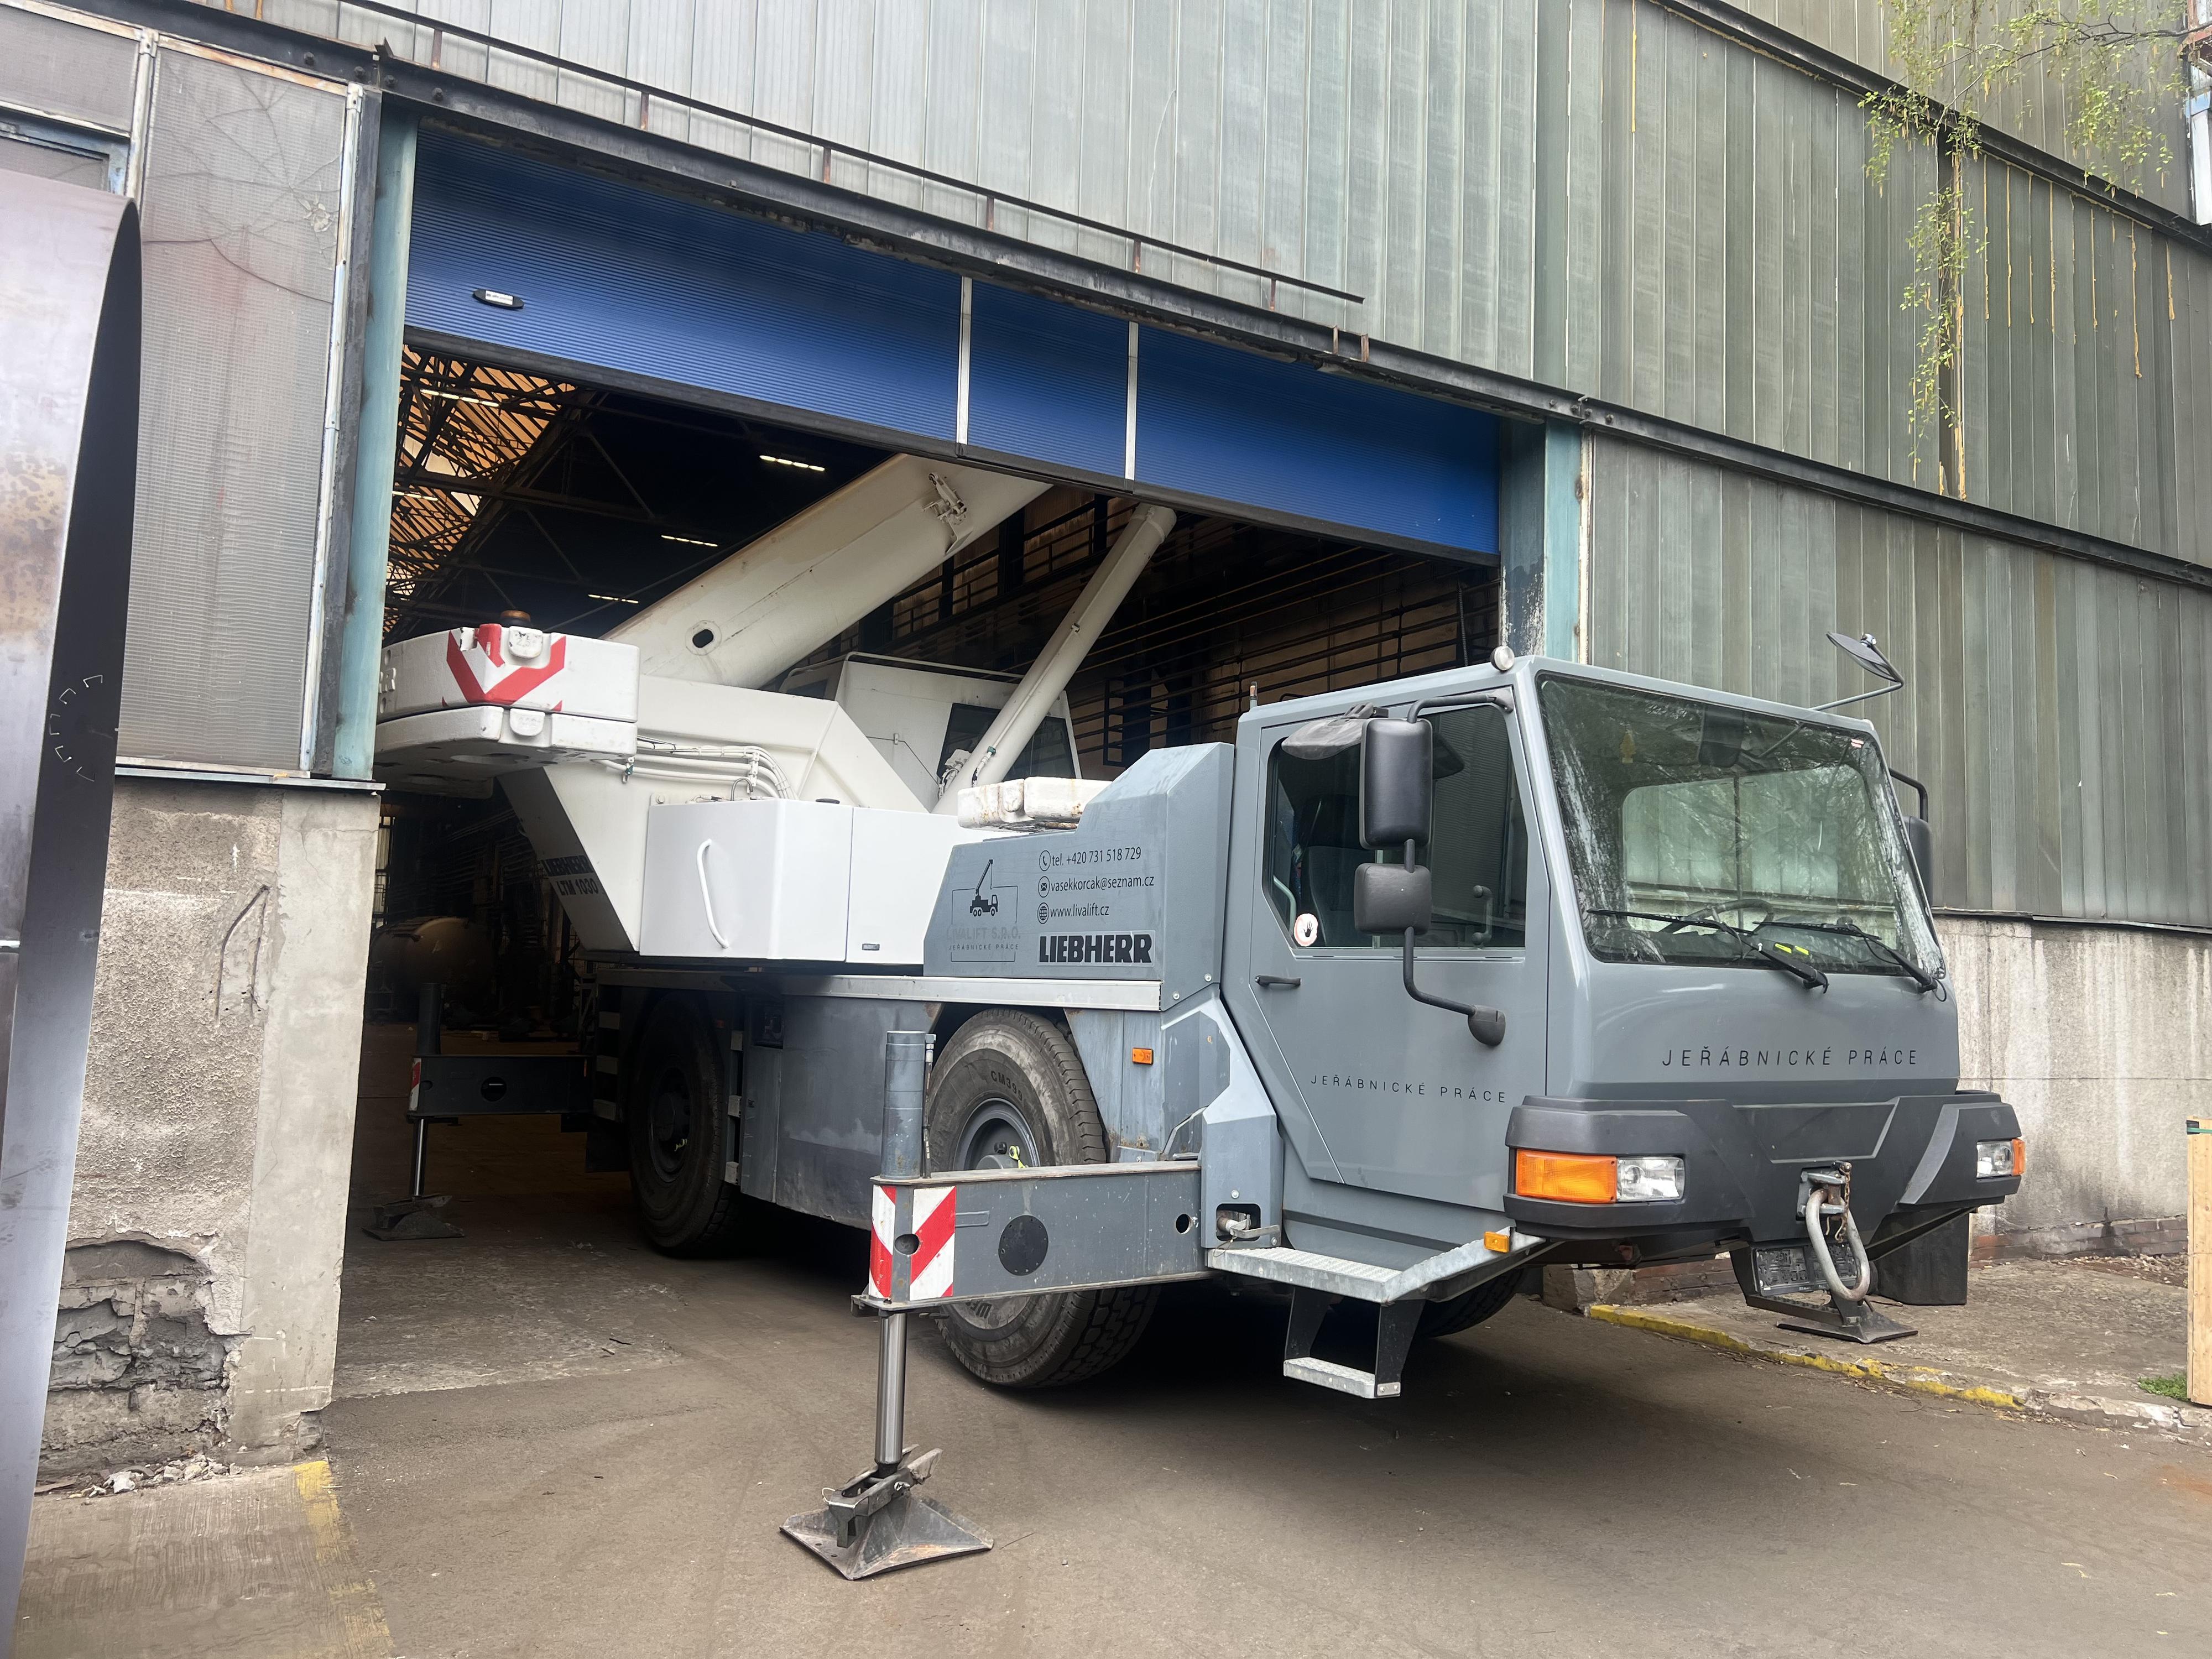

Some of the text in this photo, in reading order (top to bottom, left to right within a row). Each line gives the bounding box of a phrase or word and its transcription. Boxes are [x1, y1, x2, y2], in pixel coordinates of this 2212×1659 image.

[1052, 847, 1141, 867] tel. +420 731 518 729
[556, 878, 599, 896] LTM 1030
[1051, 875, 1155, 891] vasekkorcak@seznam.cz
[1050, 902, 1109, 917] www.livalift.cz
[1039, 933, 1152, 963] LIEBHERR
[1662, 1045, 1917, 1067] JEŘÁBNICKÉ PRÁCE
[1311, 1074, 1506, 1103] JEŘÁBNICKÉ PRÁCE
